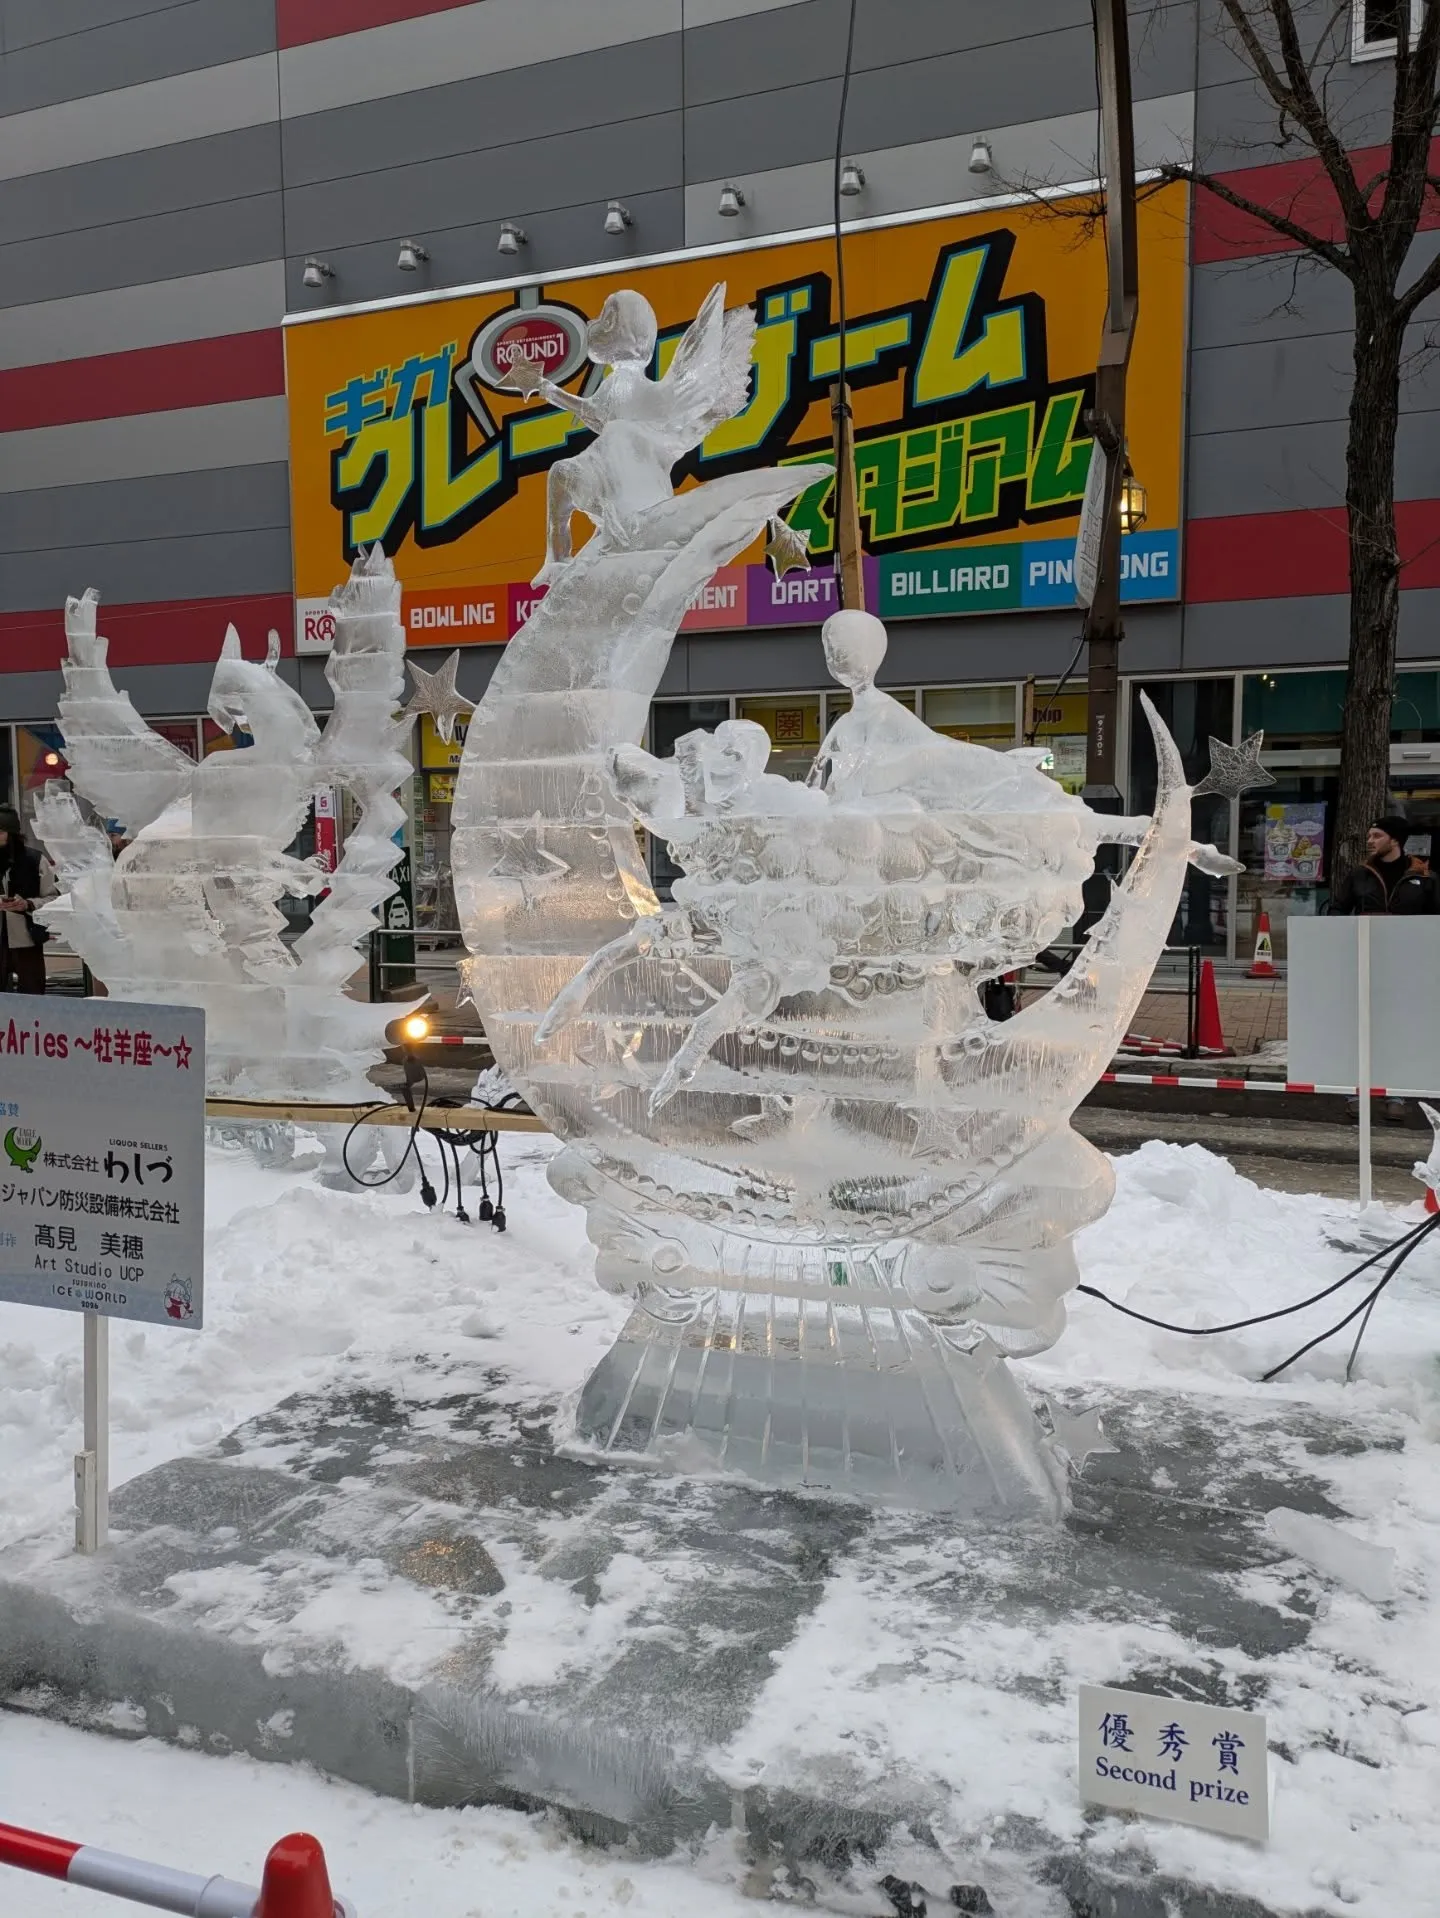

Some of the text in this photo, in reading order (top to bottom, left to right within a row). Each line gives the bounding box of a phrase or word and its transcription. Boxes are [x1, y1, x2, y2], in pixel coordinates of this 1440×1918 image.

[496, 332, 564, 364] ROUND1
[325, 340, 458, 437] ギガ
[337, 243, 1027, 549] クレーゲーム
[778, 388, 1095, 555] スタジアム
[771, 578, 844, 605] DART
[891, 564, 1010, 597] BILLIARD
[410, 602, 495, 629] BOWLING
[386, 865, 410, 883] AXI
[7, 1018, 68, 1059] Aries
[109, 1138, 168, 1151] LIQUOR SELLERS
[43, 1150, 173, 1186] 株式会社 わしづ
[1, 1183, 180, 1224] ジャパン防災設備株式会社
[100, 1231, 144, 1260] 美穂
[34, 1254, 144, 1282] Art Studio UCP
[52, 1284, 127, 1304] ICE WORLD
[1096, 1756, 1249, 1805] Second prize
